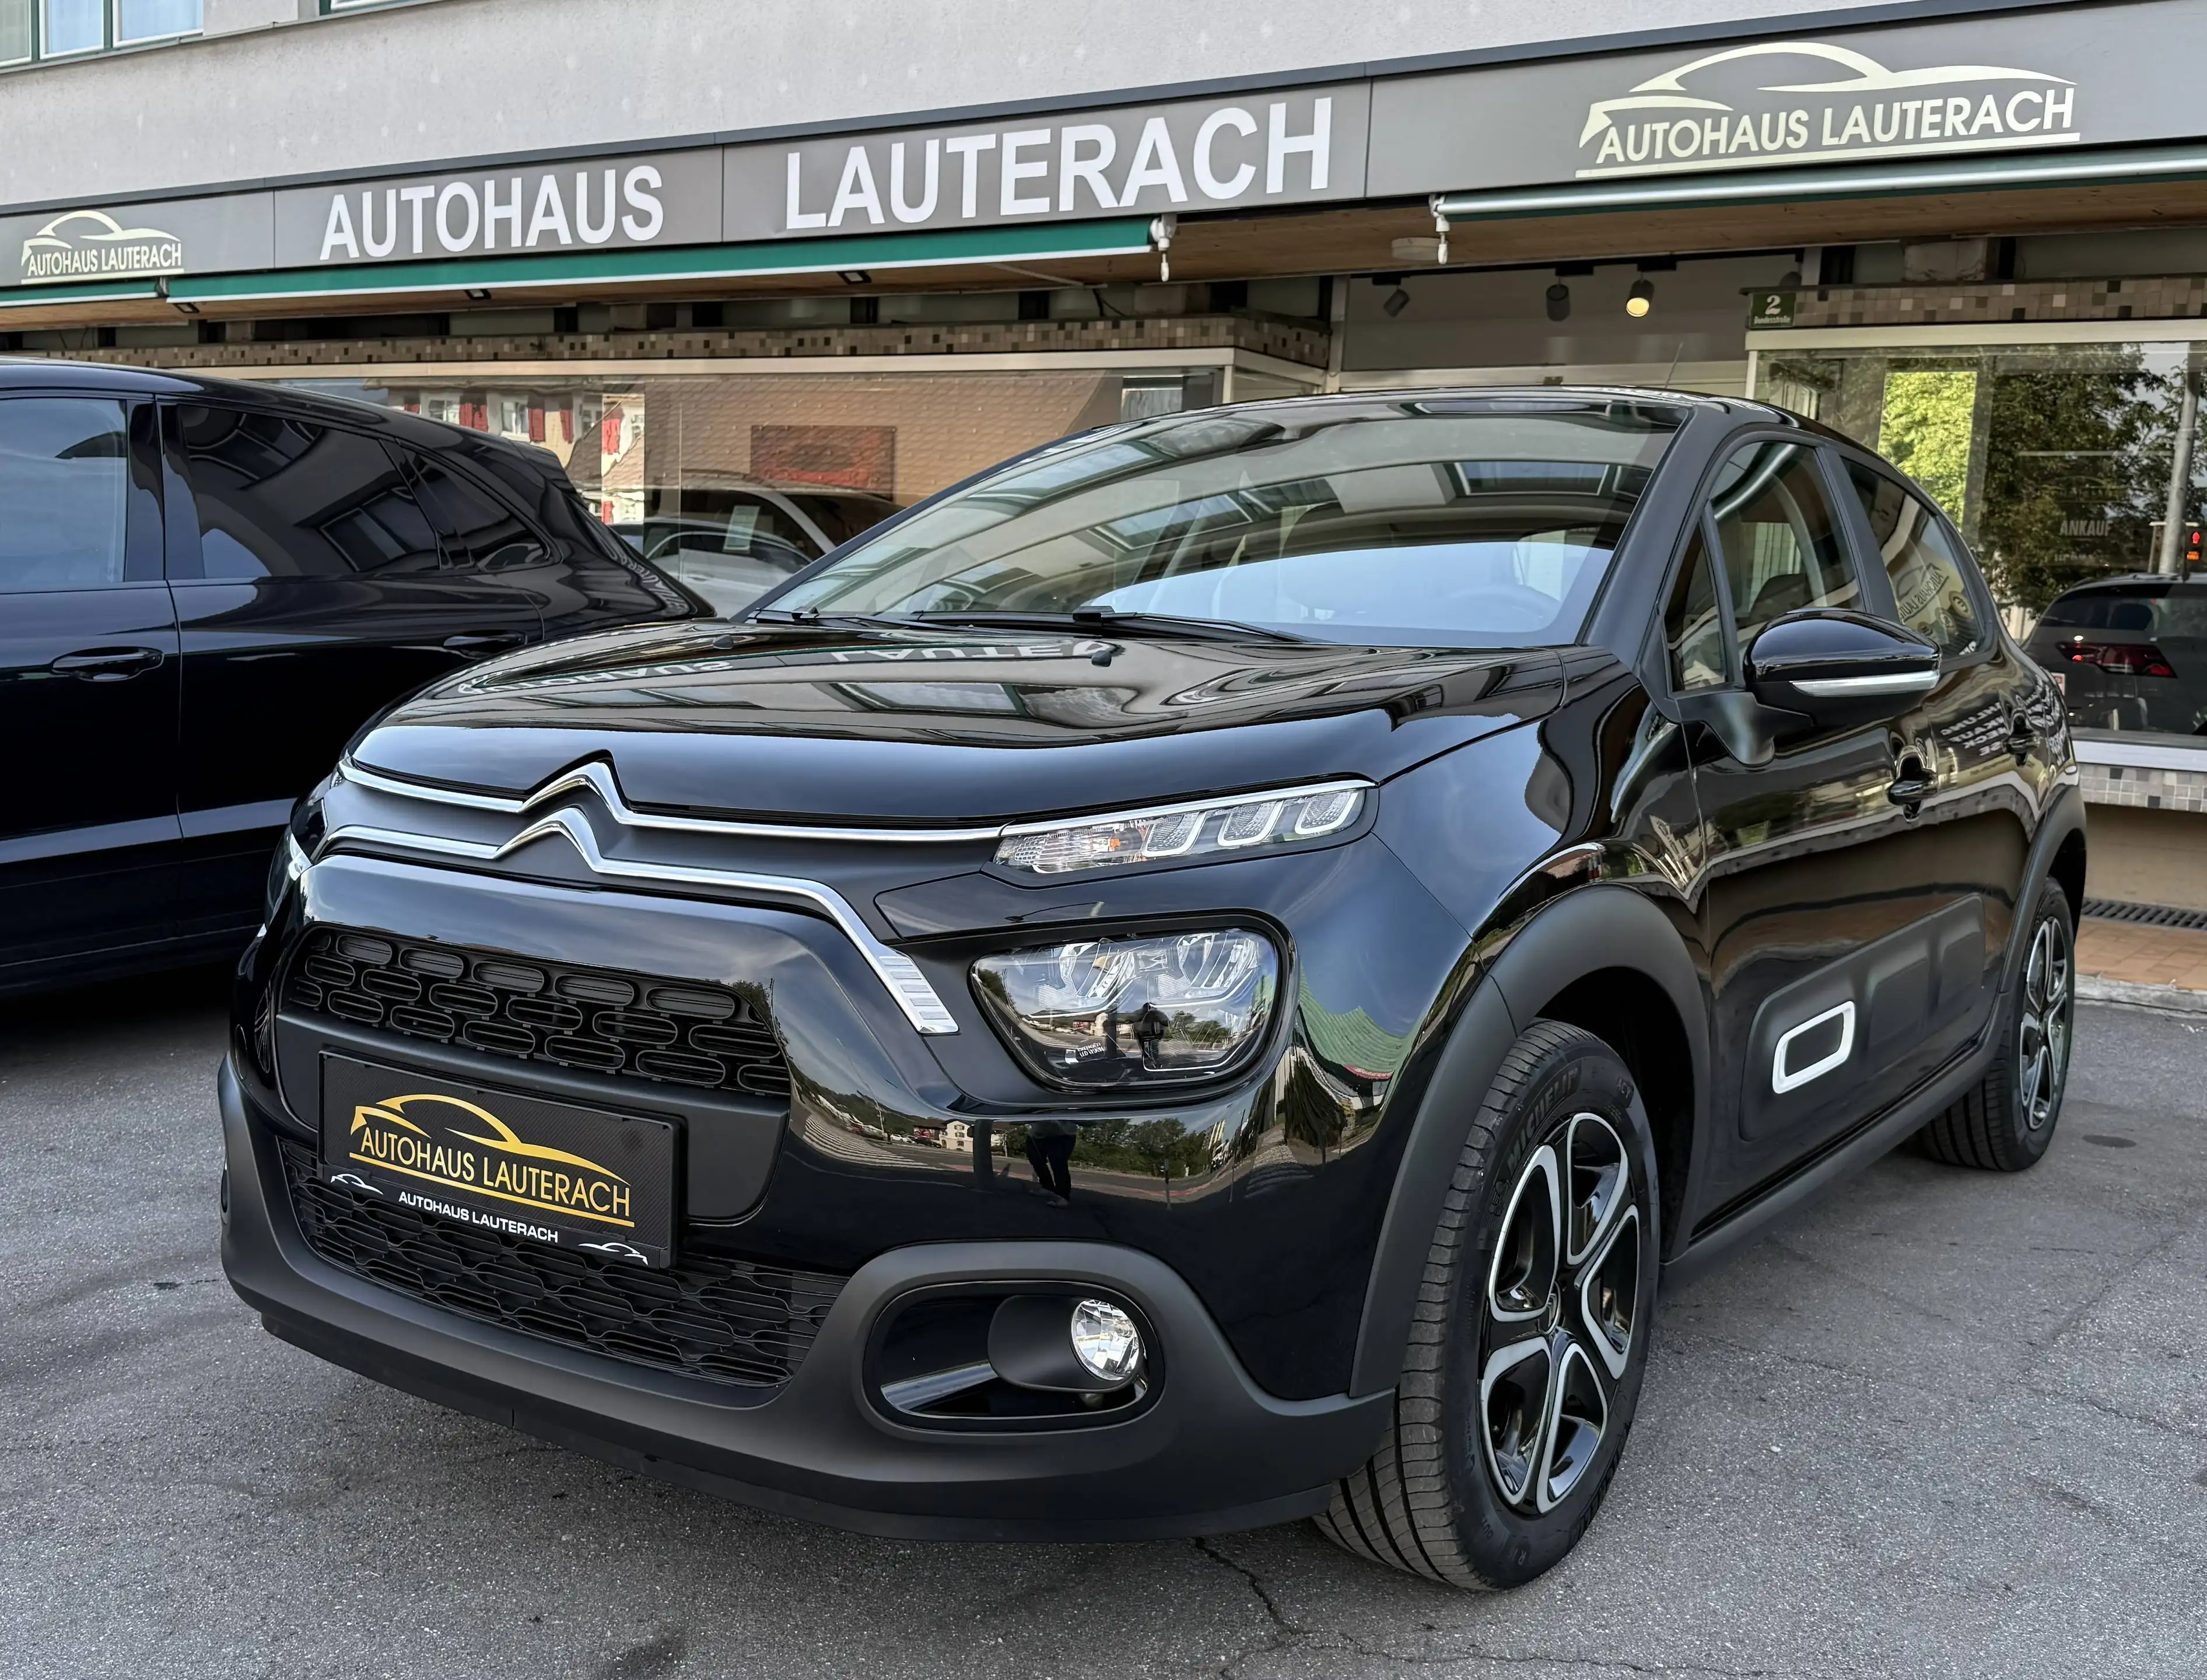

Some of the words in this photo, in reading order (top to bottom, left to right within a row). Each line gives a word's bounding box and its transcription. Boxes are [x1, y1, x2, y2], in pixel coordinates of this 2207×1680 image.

[1595, 108, 1810, 164] AUTOHAUS
[1821, 87, 2075, 146] LAUTERACH
[319, 165, 664, 261] AUTOHAUS
[786, 96, 1332, 230] LAUTERACH
[27, 248, 99, 276] AUTOHAUS
[101, 242, 182, 271] LAUTERACH
[1764, 295, 1781, 315] 2
[2059, 520, 2114, 537] ANKAUF
[360, 1127, 475, 1182] AUTOHAUS
[484, 1157, 630, 1217] LAUTERACH
[398, 1191, 470, 1221] AUTOHAUS
[472, 1211, 558, 1243] LAUTERACH
